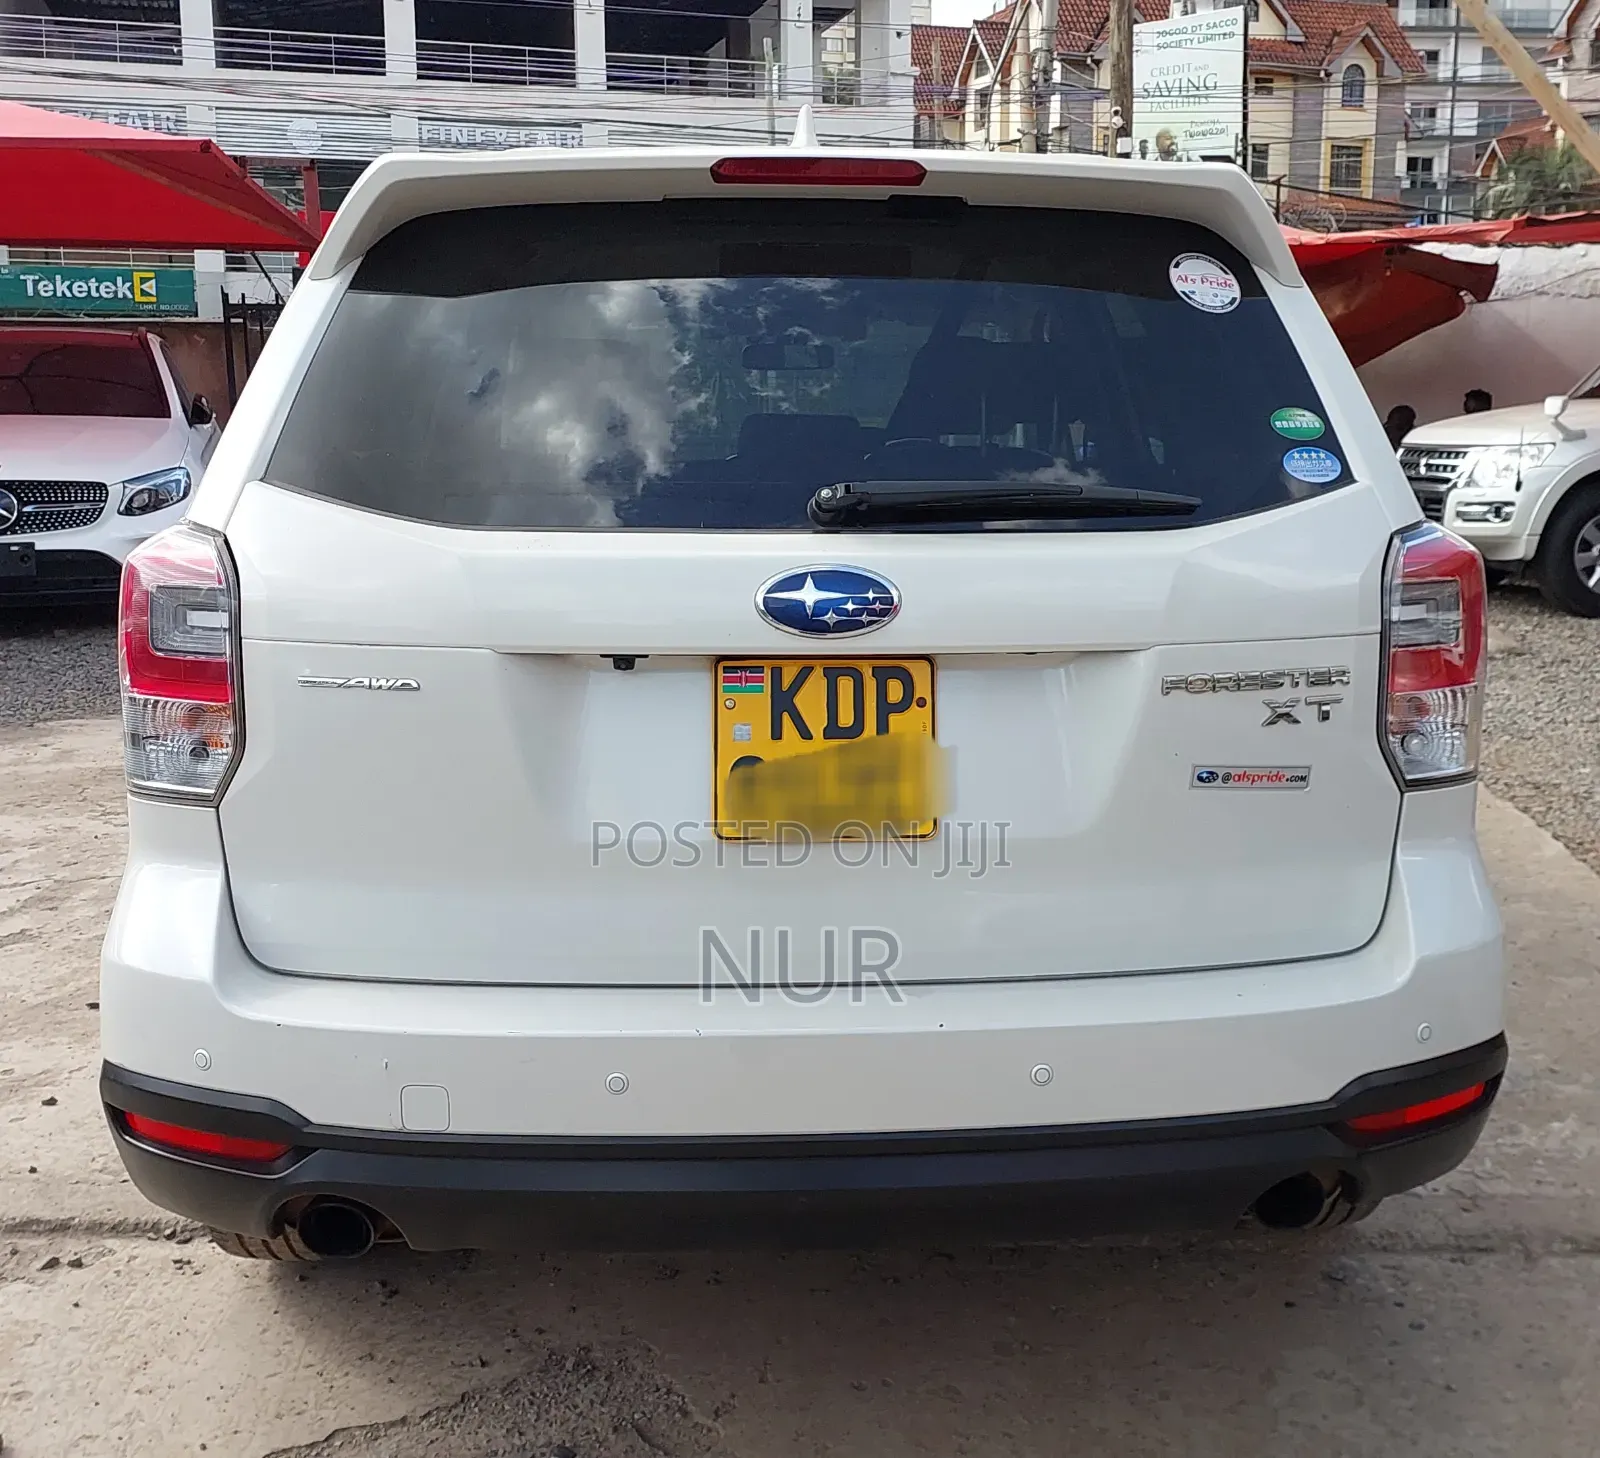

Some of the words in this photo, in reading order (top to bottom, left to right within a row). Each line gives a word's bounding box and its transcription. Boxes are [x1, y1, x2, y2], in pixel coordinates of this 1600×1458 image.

[1156, 26, 1188, 39] JOGOO
[1191, 23, 1204, 33] DT
[1206, 18, 1238, 31] SACCO
[1157, 37, 1195, 51] SOCIETY
[1197, 31, 1235, 45] LIMITED
[1150, 62, 1193, 78] CREDIT
[1194, 63, 1209, 72] AND
[1142, 73, 1218, 100] SAVING
[20, 274, 133, 299] Teketek
[1200, 276, 1235, 289] Pride
[341, 676, 420, 691] AWD
[1162, 665, 1351, 696] FORESTER
[770, 666, 915, 741] KDP
[1261, 694, 1344, 727] XT
